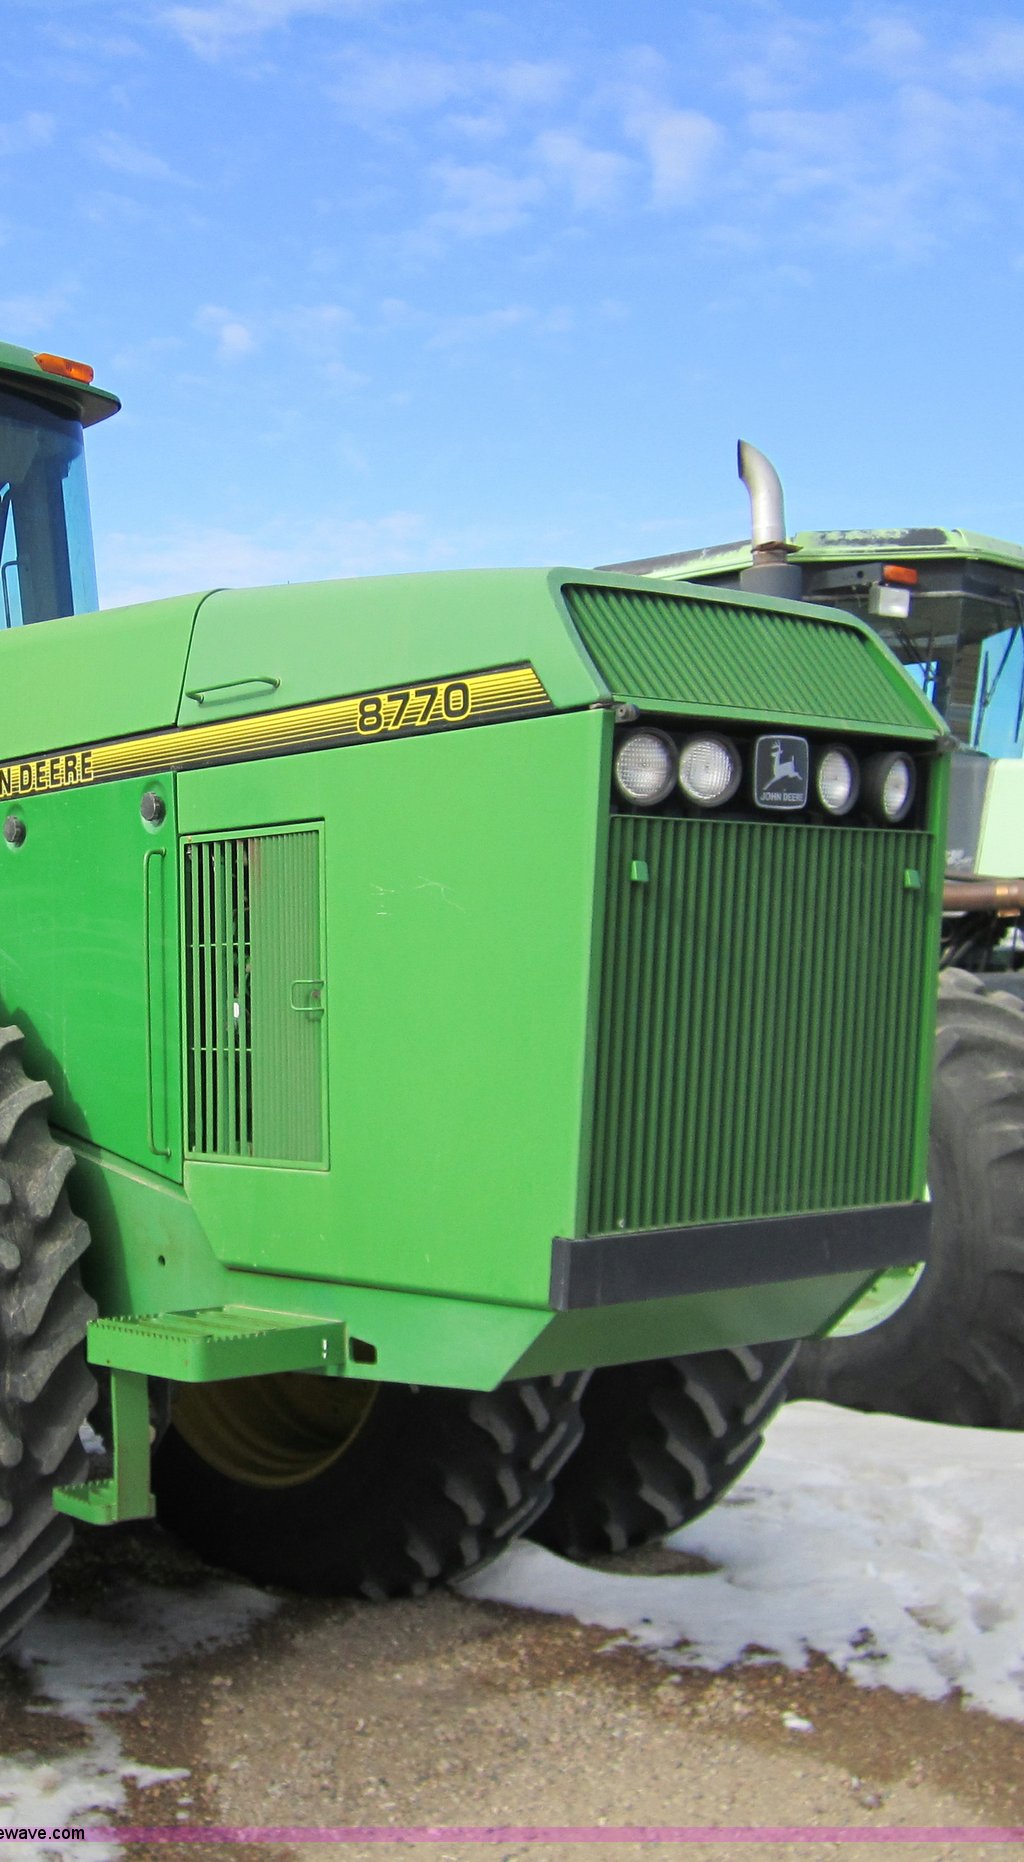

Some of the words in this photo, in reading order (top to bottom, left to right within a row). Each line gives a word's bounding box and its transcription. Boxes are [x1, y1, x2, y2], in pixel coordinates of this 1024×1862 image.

[358, 682, 470, 735] 8770
[19, 751, 93, 793] DEERE
[760, 791, 782, 801] JOHN
[783, 792, 804, 802] DEERE
